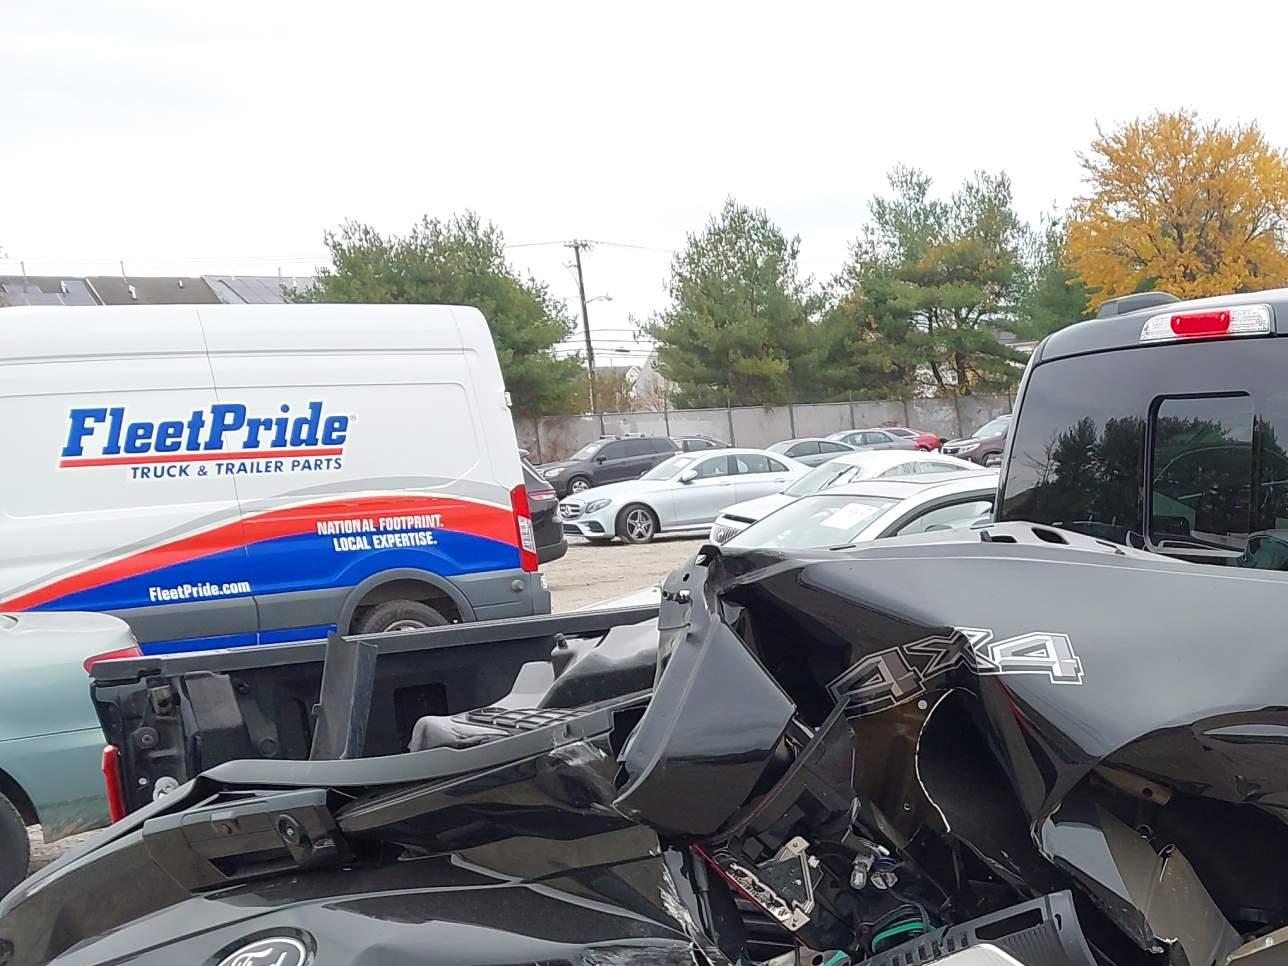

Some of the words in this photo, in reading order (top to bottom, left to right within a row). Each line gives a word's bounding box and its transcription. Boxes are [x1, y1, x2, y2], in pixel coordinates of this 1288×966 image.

[62, 401, 349, 457] FleetPride
[131, 464, 190, 480] TRUCK
[197, 466, 208, 477] &
[215, 460, 284, 475] TRAILER
[291, 457, 342, 472] PARTS
[316, 518, 376, 535] NATIONAL
[379, 513, 444, 531] FOOTPRINT.
[333, 535, 371, 552] LOCAL
[372, 531, 438, 549] EXPERTISE.
[149, 581, 251, 602] FleetPride.com
